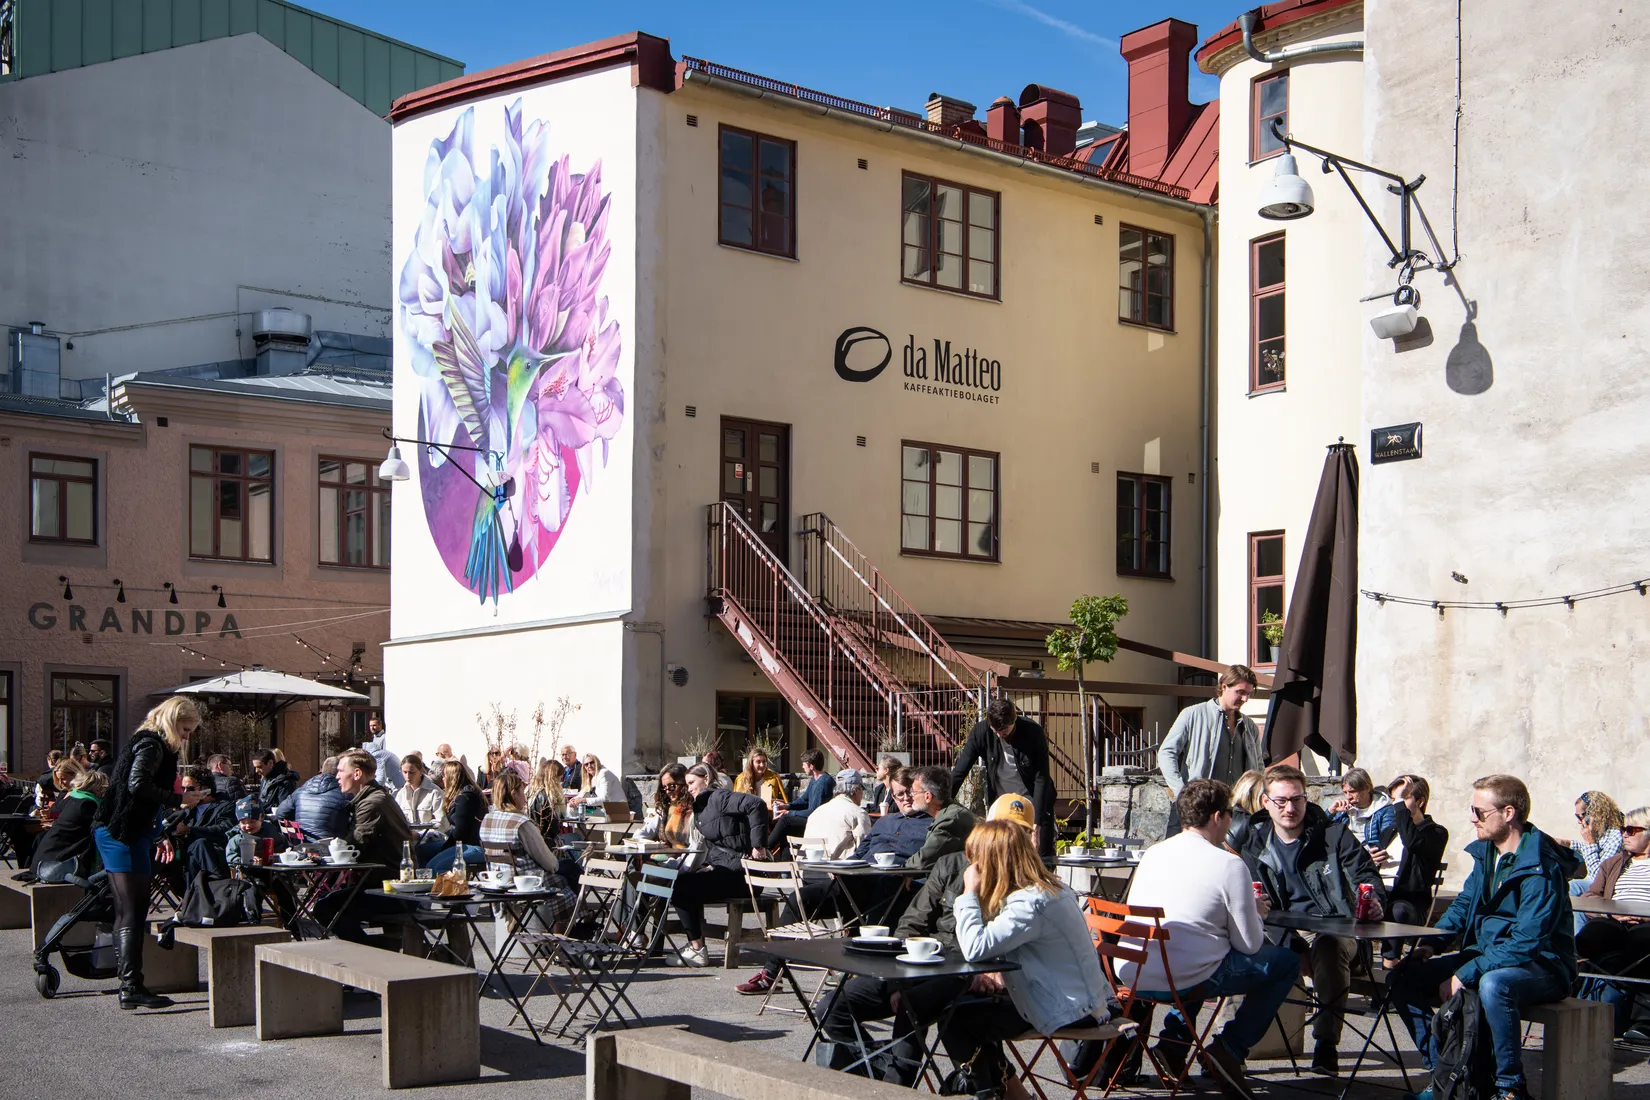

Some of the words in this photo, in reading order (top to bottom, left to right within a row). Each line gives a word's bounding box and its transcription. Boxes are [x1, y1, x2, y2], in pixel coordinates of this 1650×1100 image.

[903, 334, 928, 380] da
[933, 339, 1001, 391] Matteo
[903, 382, 1000, 405] KAFFEAKTIEBOLAGET
[1374, 447, 1416, 458] WALLENSTAM
[28, 602, 242, 639] GRANDPA
